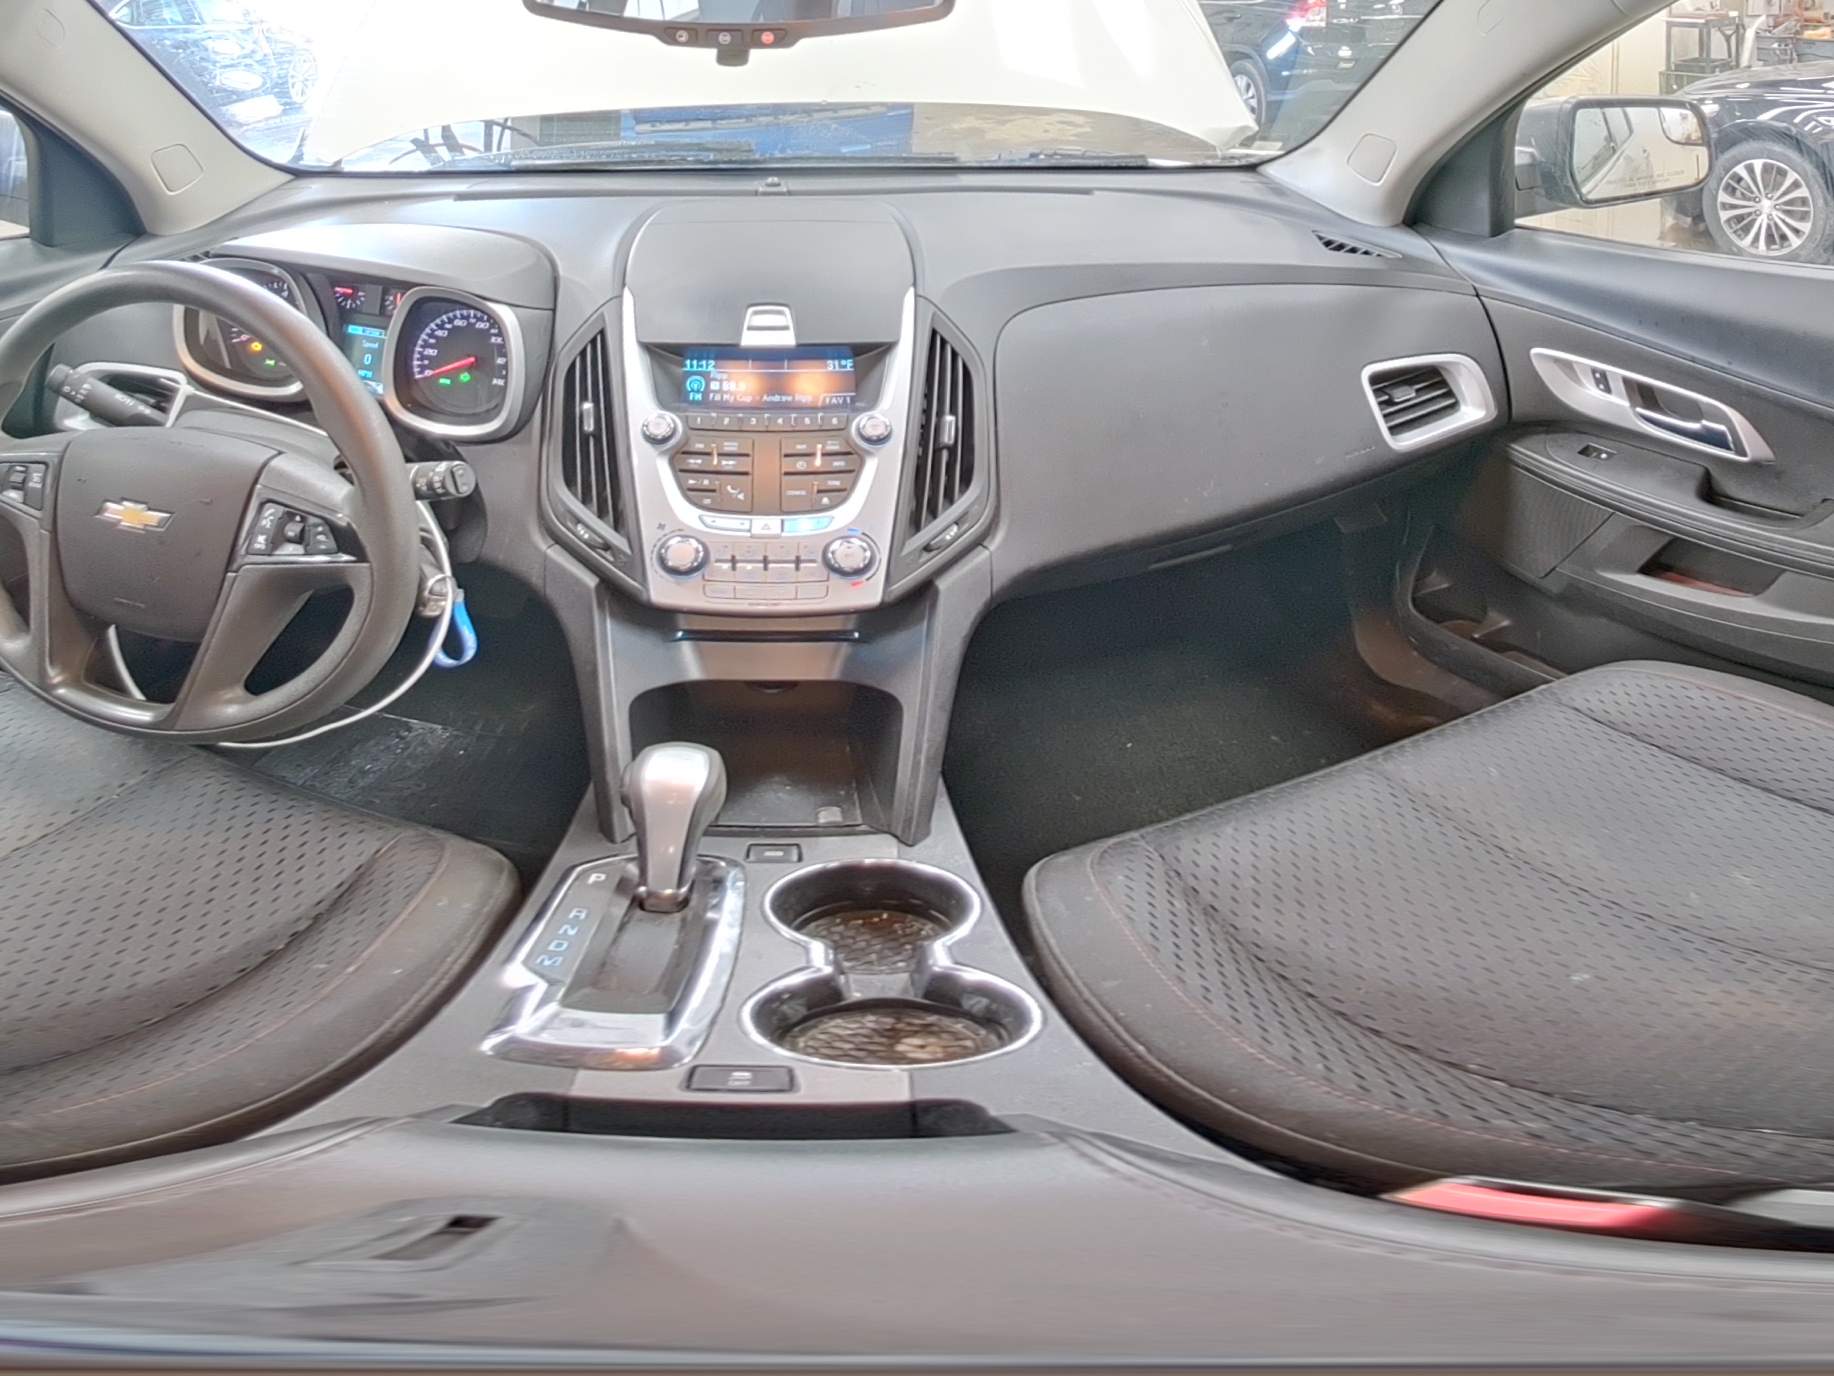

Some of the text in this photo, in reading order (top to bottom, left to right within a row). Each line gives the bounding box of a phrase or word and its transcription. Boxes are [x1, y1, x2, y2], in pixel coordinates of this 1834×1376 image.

[364, 354, 372, 365] 0
[685, 359, 715, 370] 11:12
[689, 393, 702, 401] FM
[724, 394, 734, 404] My
[762, 394, 793, 402] Andrew
[825, 396, 843, 404] FAV
[587, 873, 607, 884] P
[558, 924, 579, 935] N
[547, 939, 569, 951] D
[535, 955, 564, 966] M
